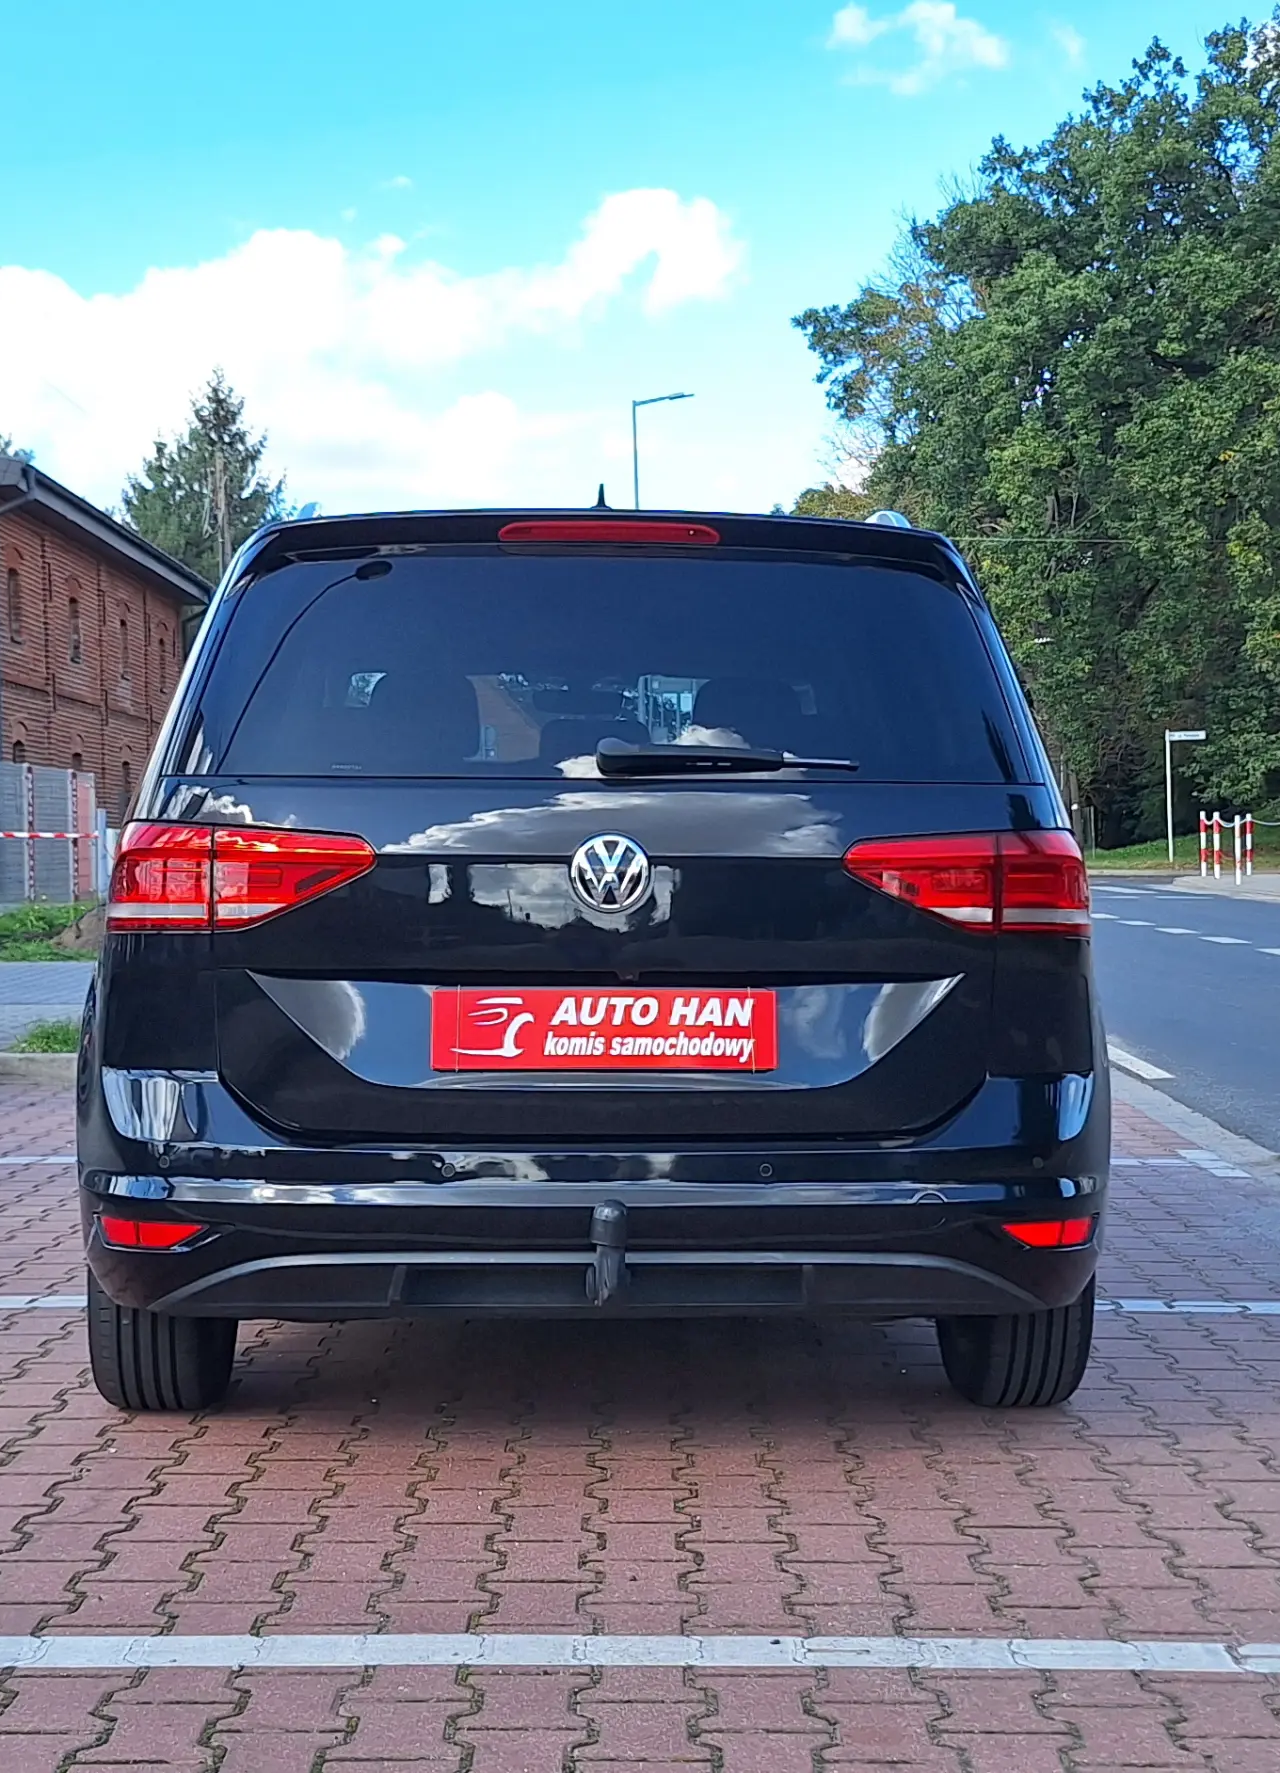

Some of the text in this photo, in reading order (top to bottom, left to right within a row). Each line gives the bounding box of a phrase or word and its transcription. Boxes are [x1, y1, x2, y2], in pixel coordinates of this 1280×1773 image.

[548, 996, 754, 1027] AUTO HAN
[543, 1031, 756, 1064] komis samochodowy
